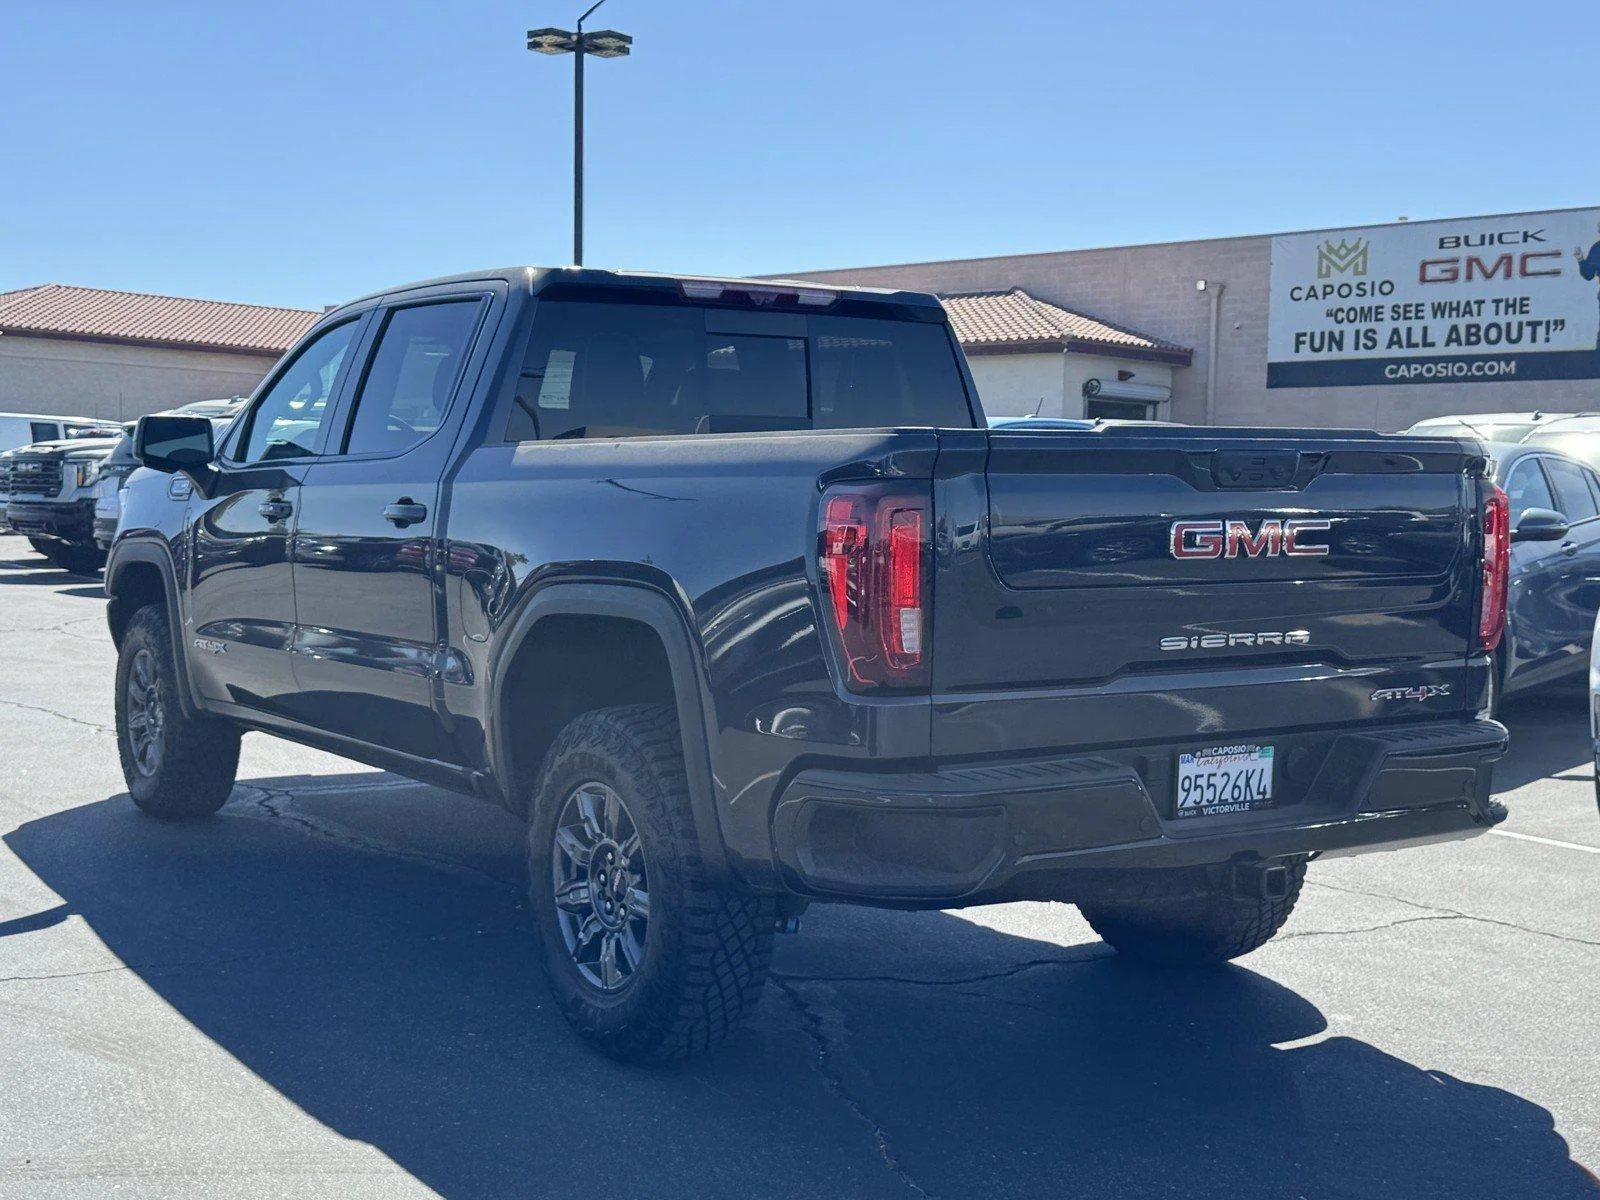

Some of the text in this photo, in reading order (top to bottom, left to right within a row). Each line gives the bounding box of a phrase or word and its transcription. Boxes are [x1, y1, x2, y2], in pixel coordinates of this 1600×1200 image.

[1438, 228, 1547, 250] BUICK
[1418, 249, 1562, 286] GMC
[1289, 280, 1395, 302] CAPOSIO
[1390, 302, 1425, 321] SEE
[1431, 299, 1485, 319] WHAT
[1491, 296, 1531, 316] THE
[1294, 329, 1345, 354] FUN
[1354, 328, 1378, 351] IS
[1385, 324, 1436, 349] ALL
[1384, 360, 1517, 379] CAPOSIO.COM
[1169, 518, 1332, 561] GMC
[1159, 629, 1311, 652] SIERRA
[1370, 683, 1451, 703] AT4X
[1212, 745, 1247, 755] CAPOSIO
[1179, 768, 1268, 807] 95526K4
[1202, 803, 1250, 815] VICTORVILLE
